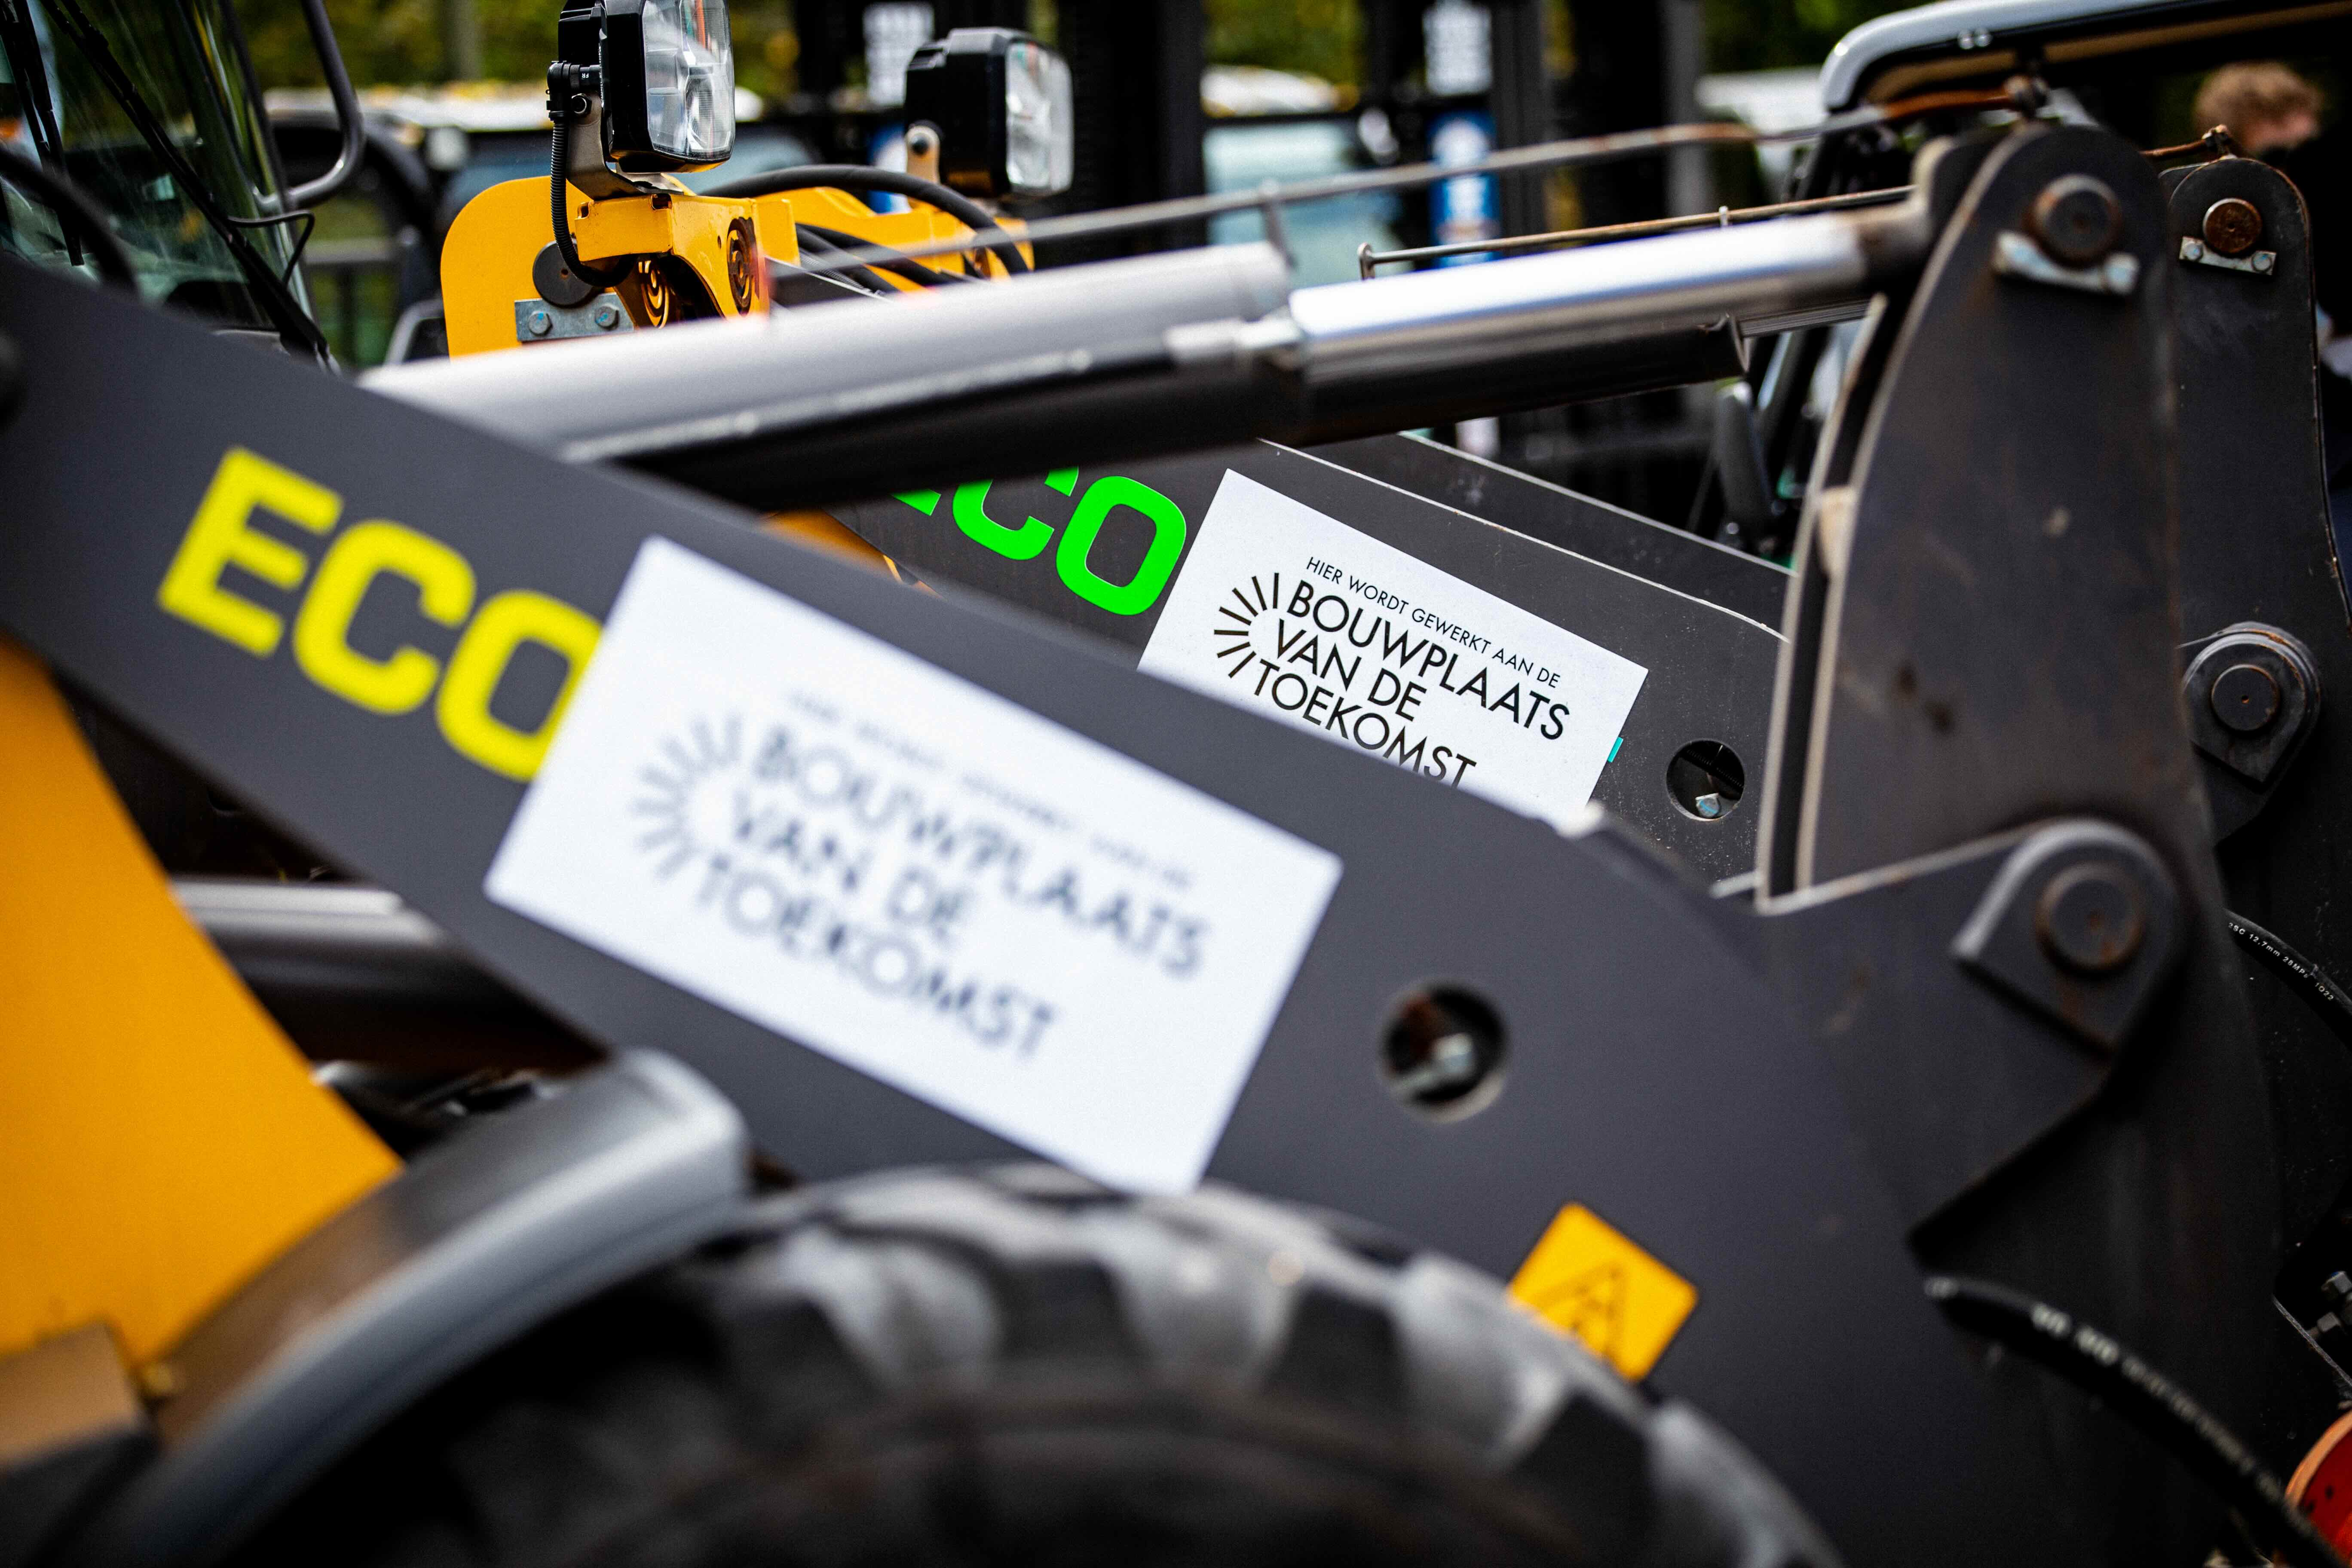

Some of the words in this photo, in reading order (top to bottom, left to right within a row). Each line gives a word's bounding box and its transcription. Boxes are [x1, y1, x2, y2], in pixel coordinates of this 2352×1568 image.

[157, 445, 604, 783] ECO
[889, 466, 1187, 616] CO
[1277, 618, 1363, 692] VAN
[1367, 668, 1427, 722] DE
[1286, 579, 1570, 741] BOUWPLAATS
[1306, 557, 1342, 585] HIER
[1349, 575, 1409, 615] WORDT
[1412, 608, 1492, 654] GEWERKT
[1491, 648, 1534, 676] AAN
[1536, 667, 1561, 689] DE
[1253, 658, 1477, 788] TOEKOMST
[731, 790, 870, 893] VAN
[885, 864, 973, 947] DE
[751, 722, 1210, 979] BOUWPLAATS
[697, 853, 1057, 1060] TOEKOMST
[2249, 933, 2280, 957] 12.7mm
